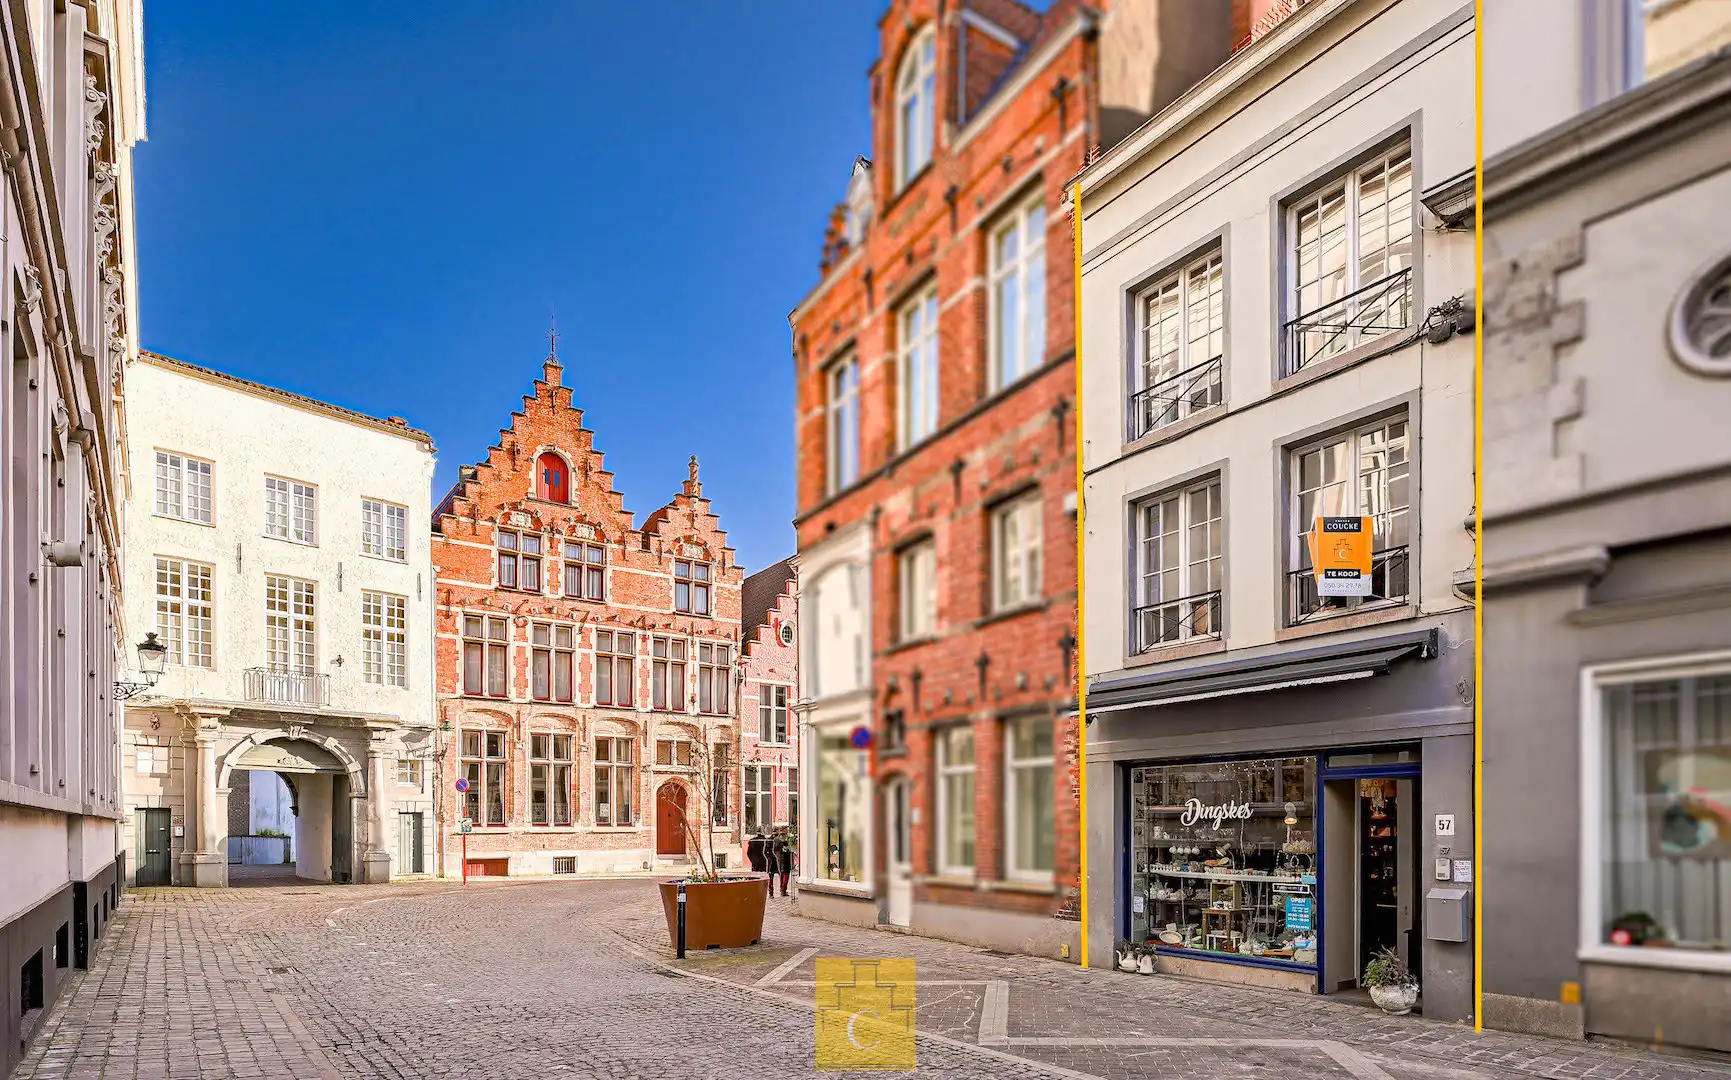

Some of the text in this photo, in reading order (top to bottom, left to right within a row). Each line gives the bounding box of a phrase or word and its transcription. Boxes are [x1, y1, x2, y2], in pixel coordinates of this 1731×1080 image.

[1180, 798, 1254, 831] Dingskes
[1438, 819, 1451, 831] 57
[1440, 847, 1451, 855] 57
